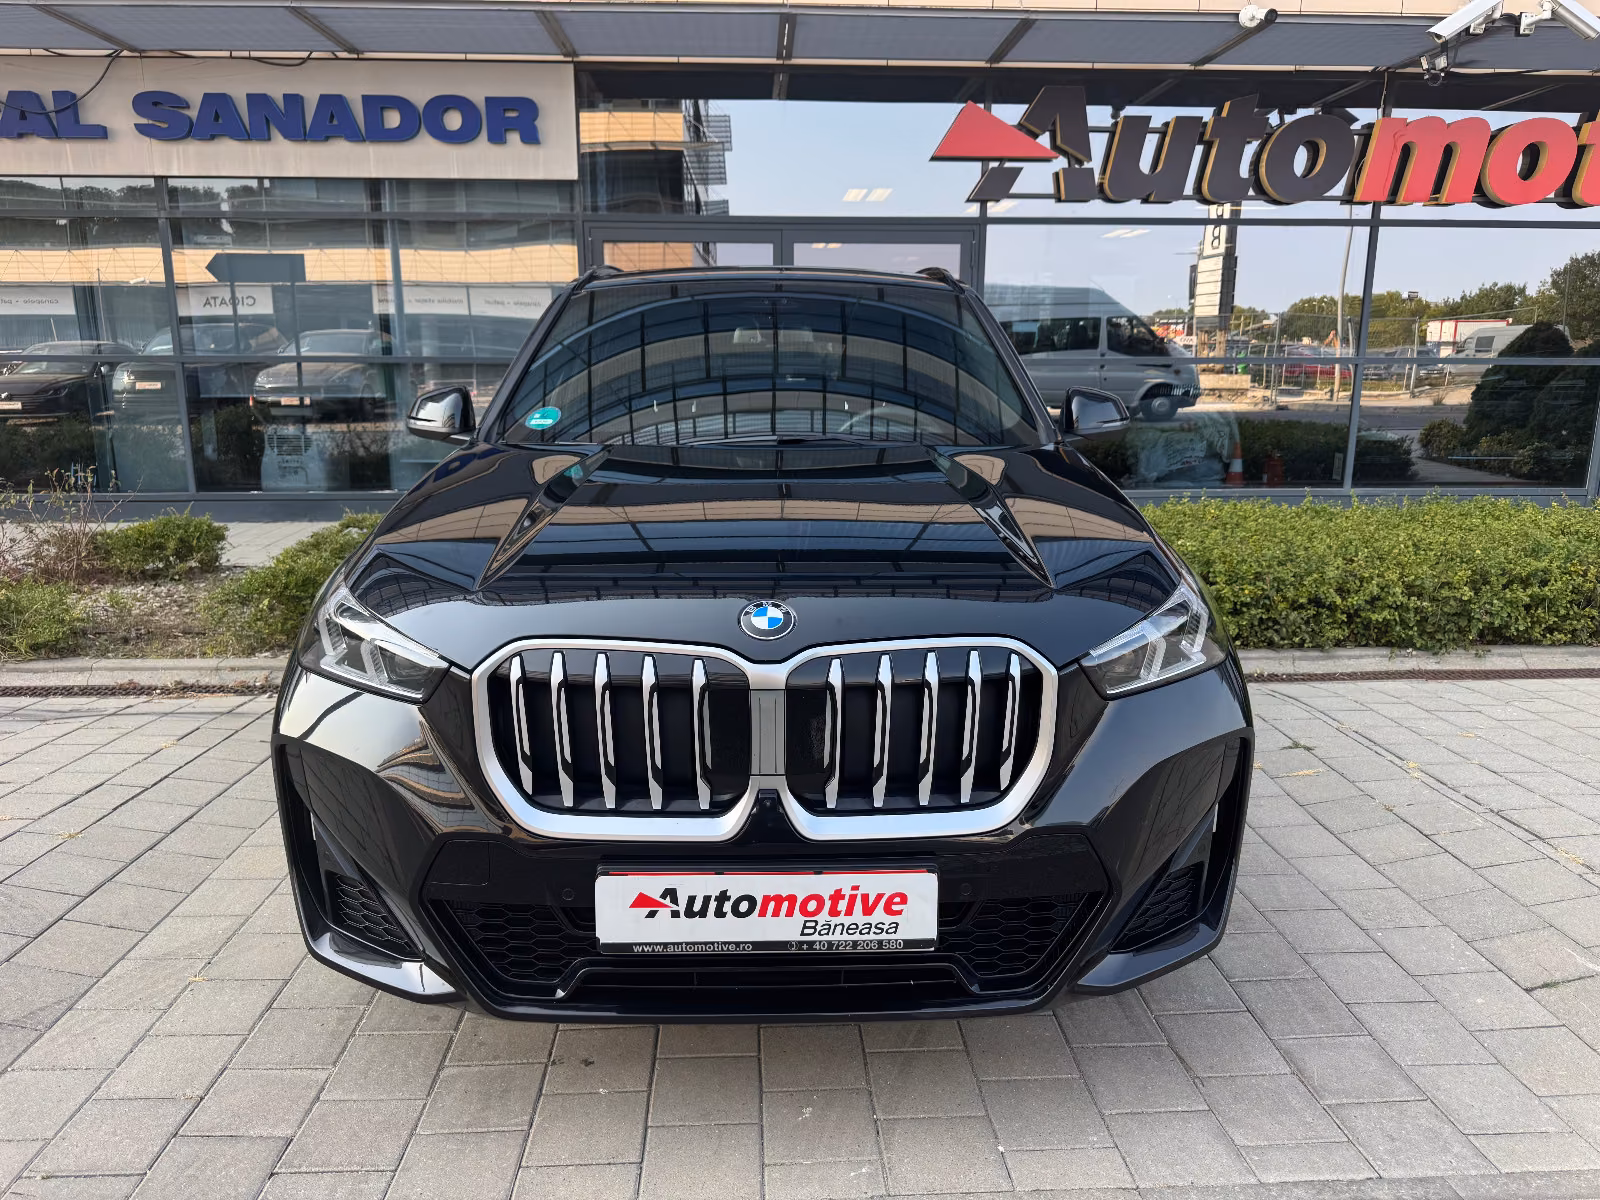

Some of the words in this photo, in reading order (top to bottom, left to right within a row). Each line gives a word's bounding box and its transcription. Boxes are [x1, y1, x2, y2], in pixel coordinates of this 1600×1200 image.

[131, 90, 541, 145] SANADOR
[629, 885, 908, 919] Automotive
[800, 919, 899, 937] Băneasa
[632, 942, 753, 953] www.automotive.ro
[813, 941, 828, 951] 40
[832, 941, 852, 951] 722
[857, 940, 878, 950] 206
[882, 940, 904, 950] 580
